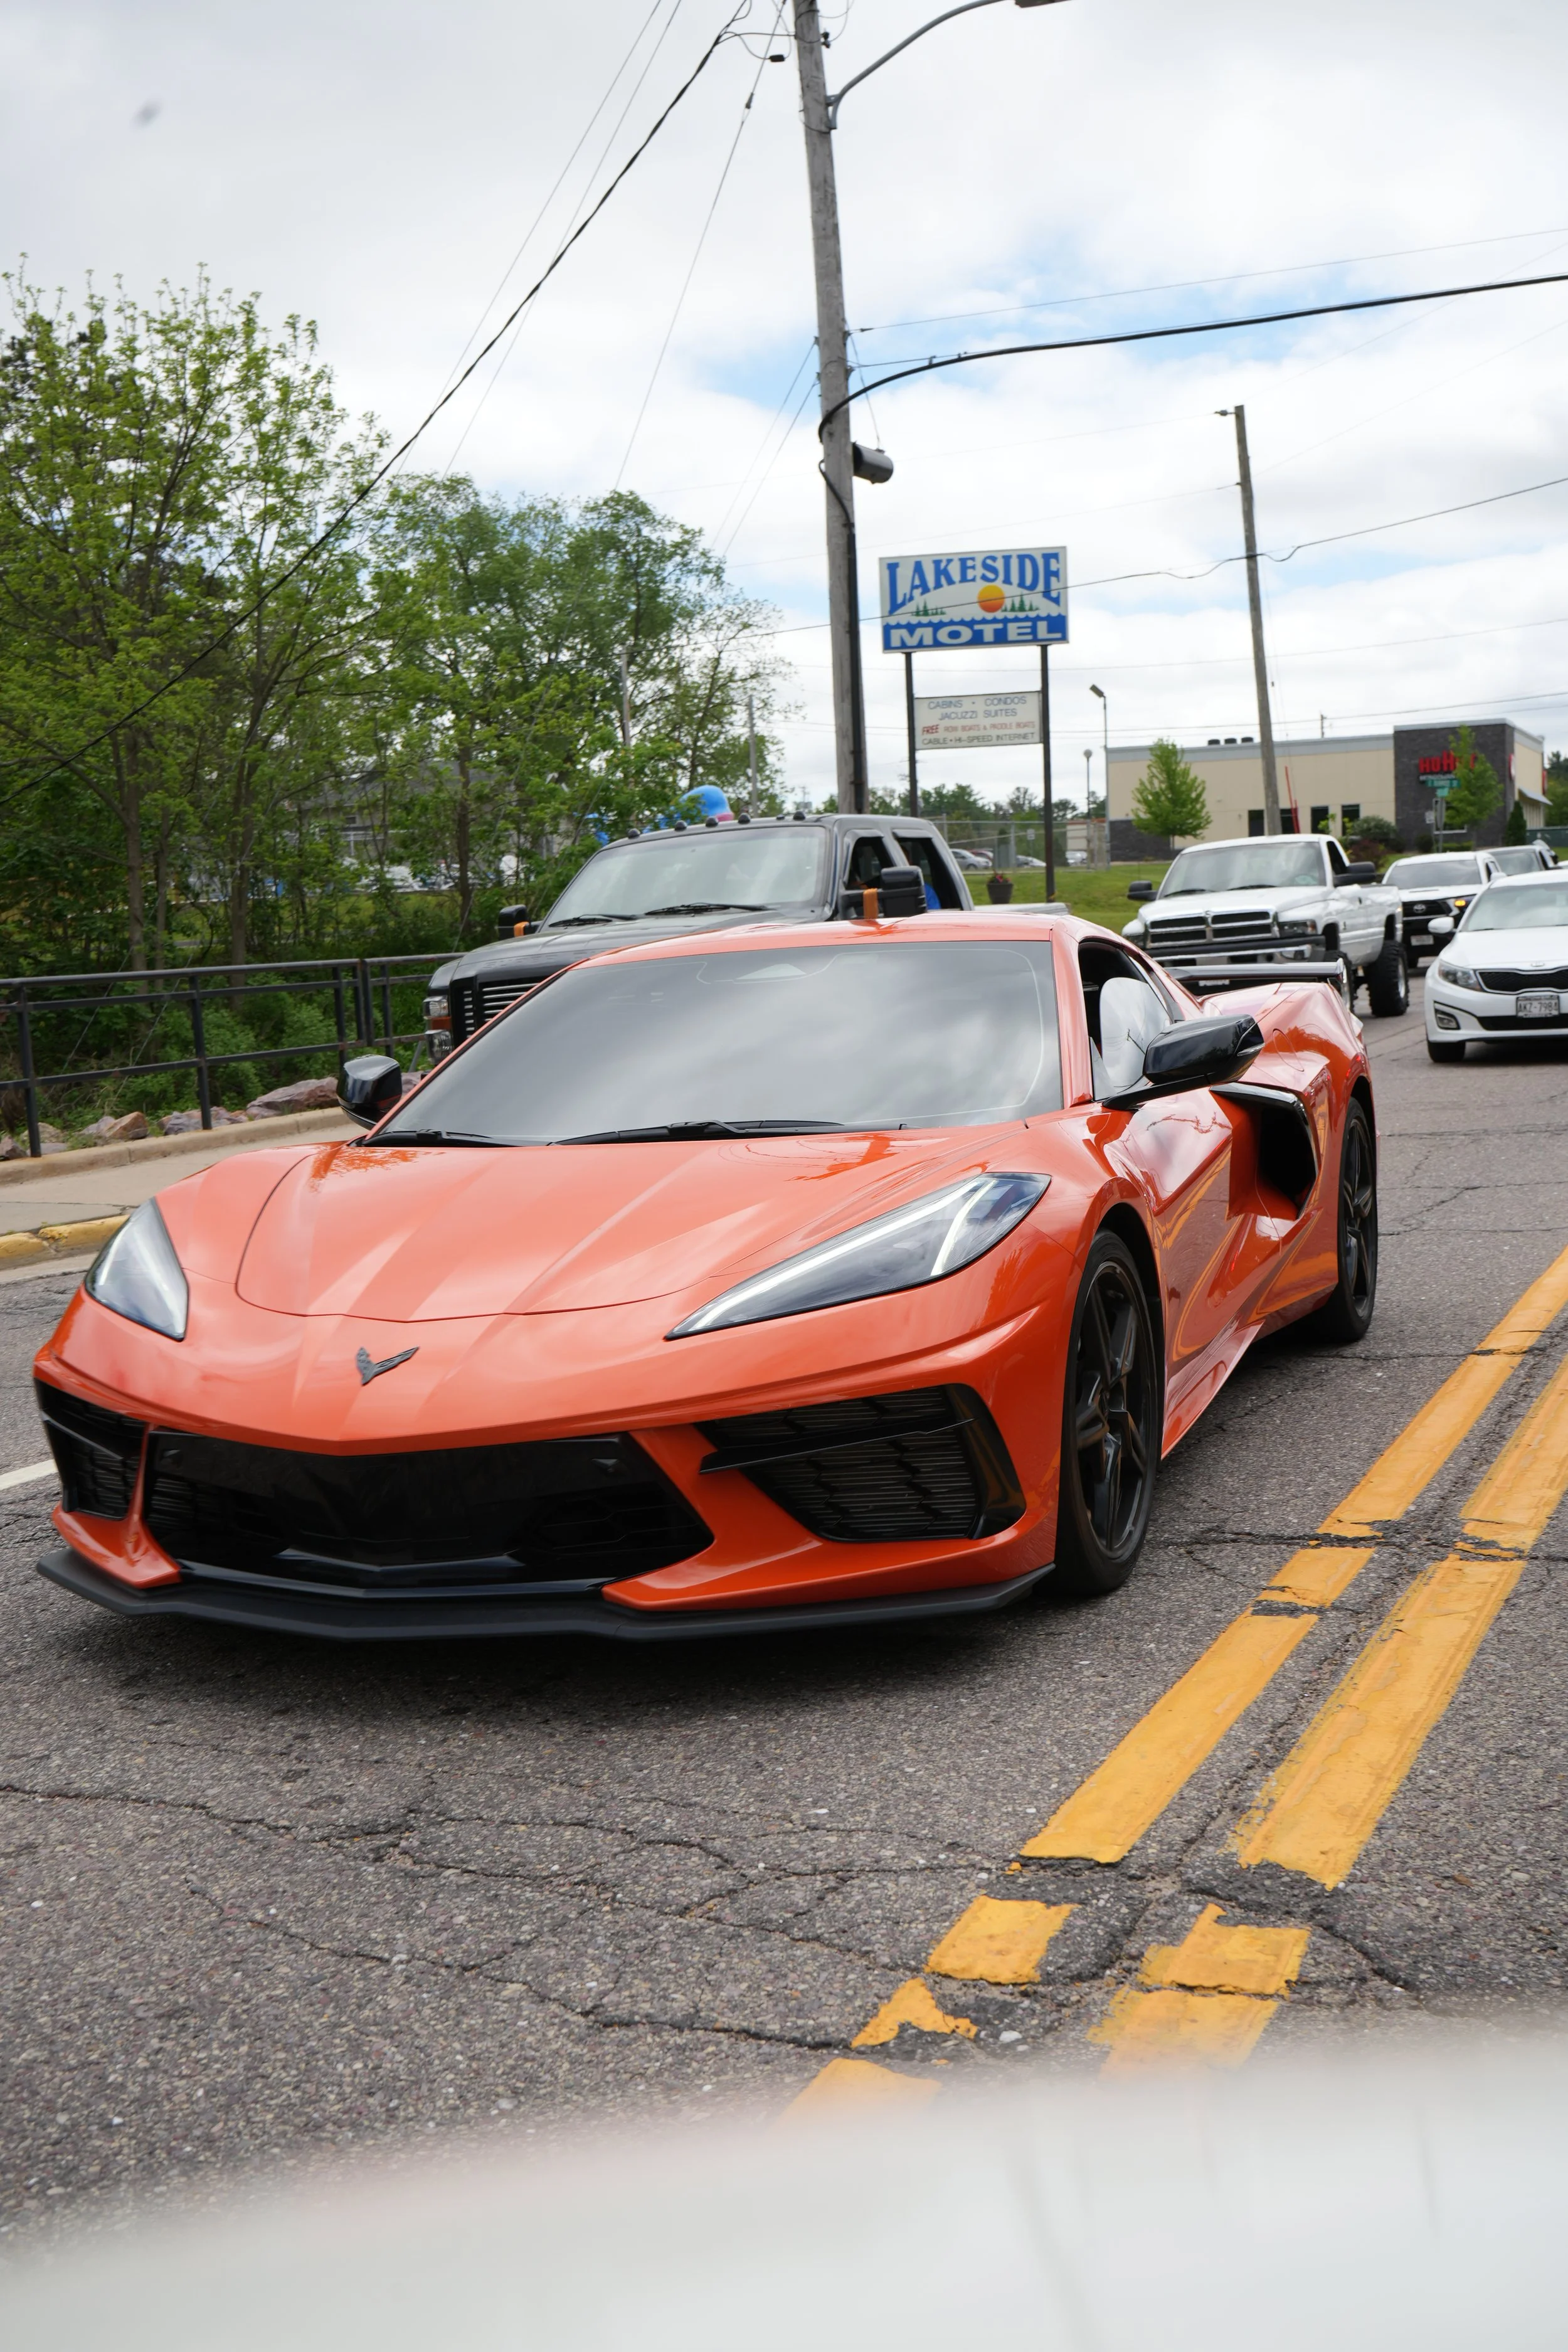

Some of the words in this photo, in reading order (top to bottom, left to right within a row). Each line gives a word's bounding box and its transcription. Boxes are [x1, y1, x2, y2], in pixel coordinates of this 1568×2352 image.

[886, 552, 1060, 616] LAKESIDE
[890, 621, 1062, 647] MOTEL
[928, 699, 963, 709] CABINS
[985, 696, 1027, 707] CONDOS
[939, 711, 978, 721] JACUZZI
[983, 708, 1017, 718] SUITES
[921, 724, 940, 736] FREE
[961, 724, 980, 732] BOATS
[954, 735, 993, 744] HI-SPEED
[996, 733, 1036, 741] INTERNET
